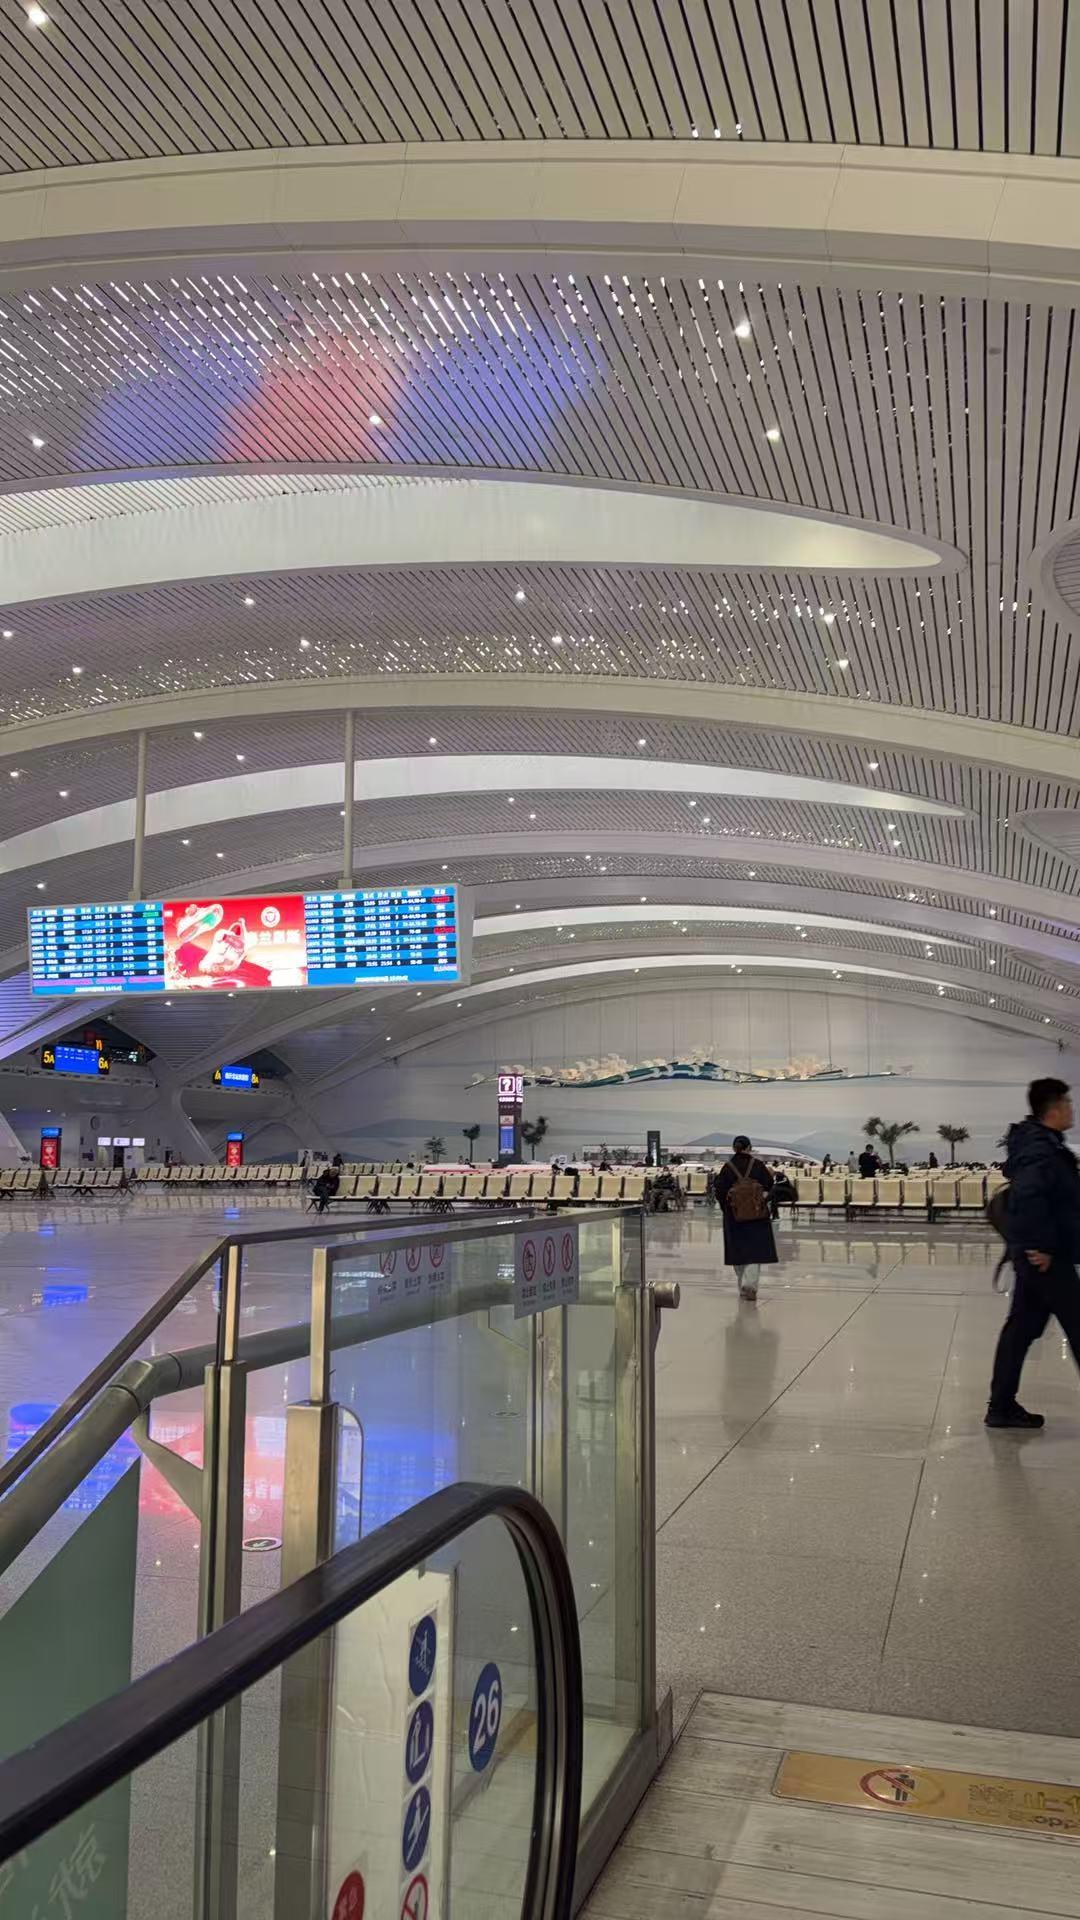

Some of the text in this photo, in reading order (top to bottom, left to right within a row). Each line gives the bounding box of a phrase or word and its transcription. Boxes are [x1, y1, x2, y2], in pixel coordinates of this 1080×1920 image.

[43, 1051, 55, 1064] 5A
[98, 1057, 109, 1069] 6A
[473, 1679, 499, 1755] 26
